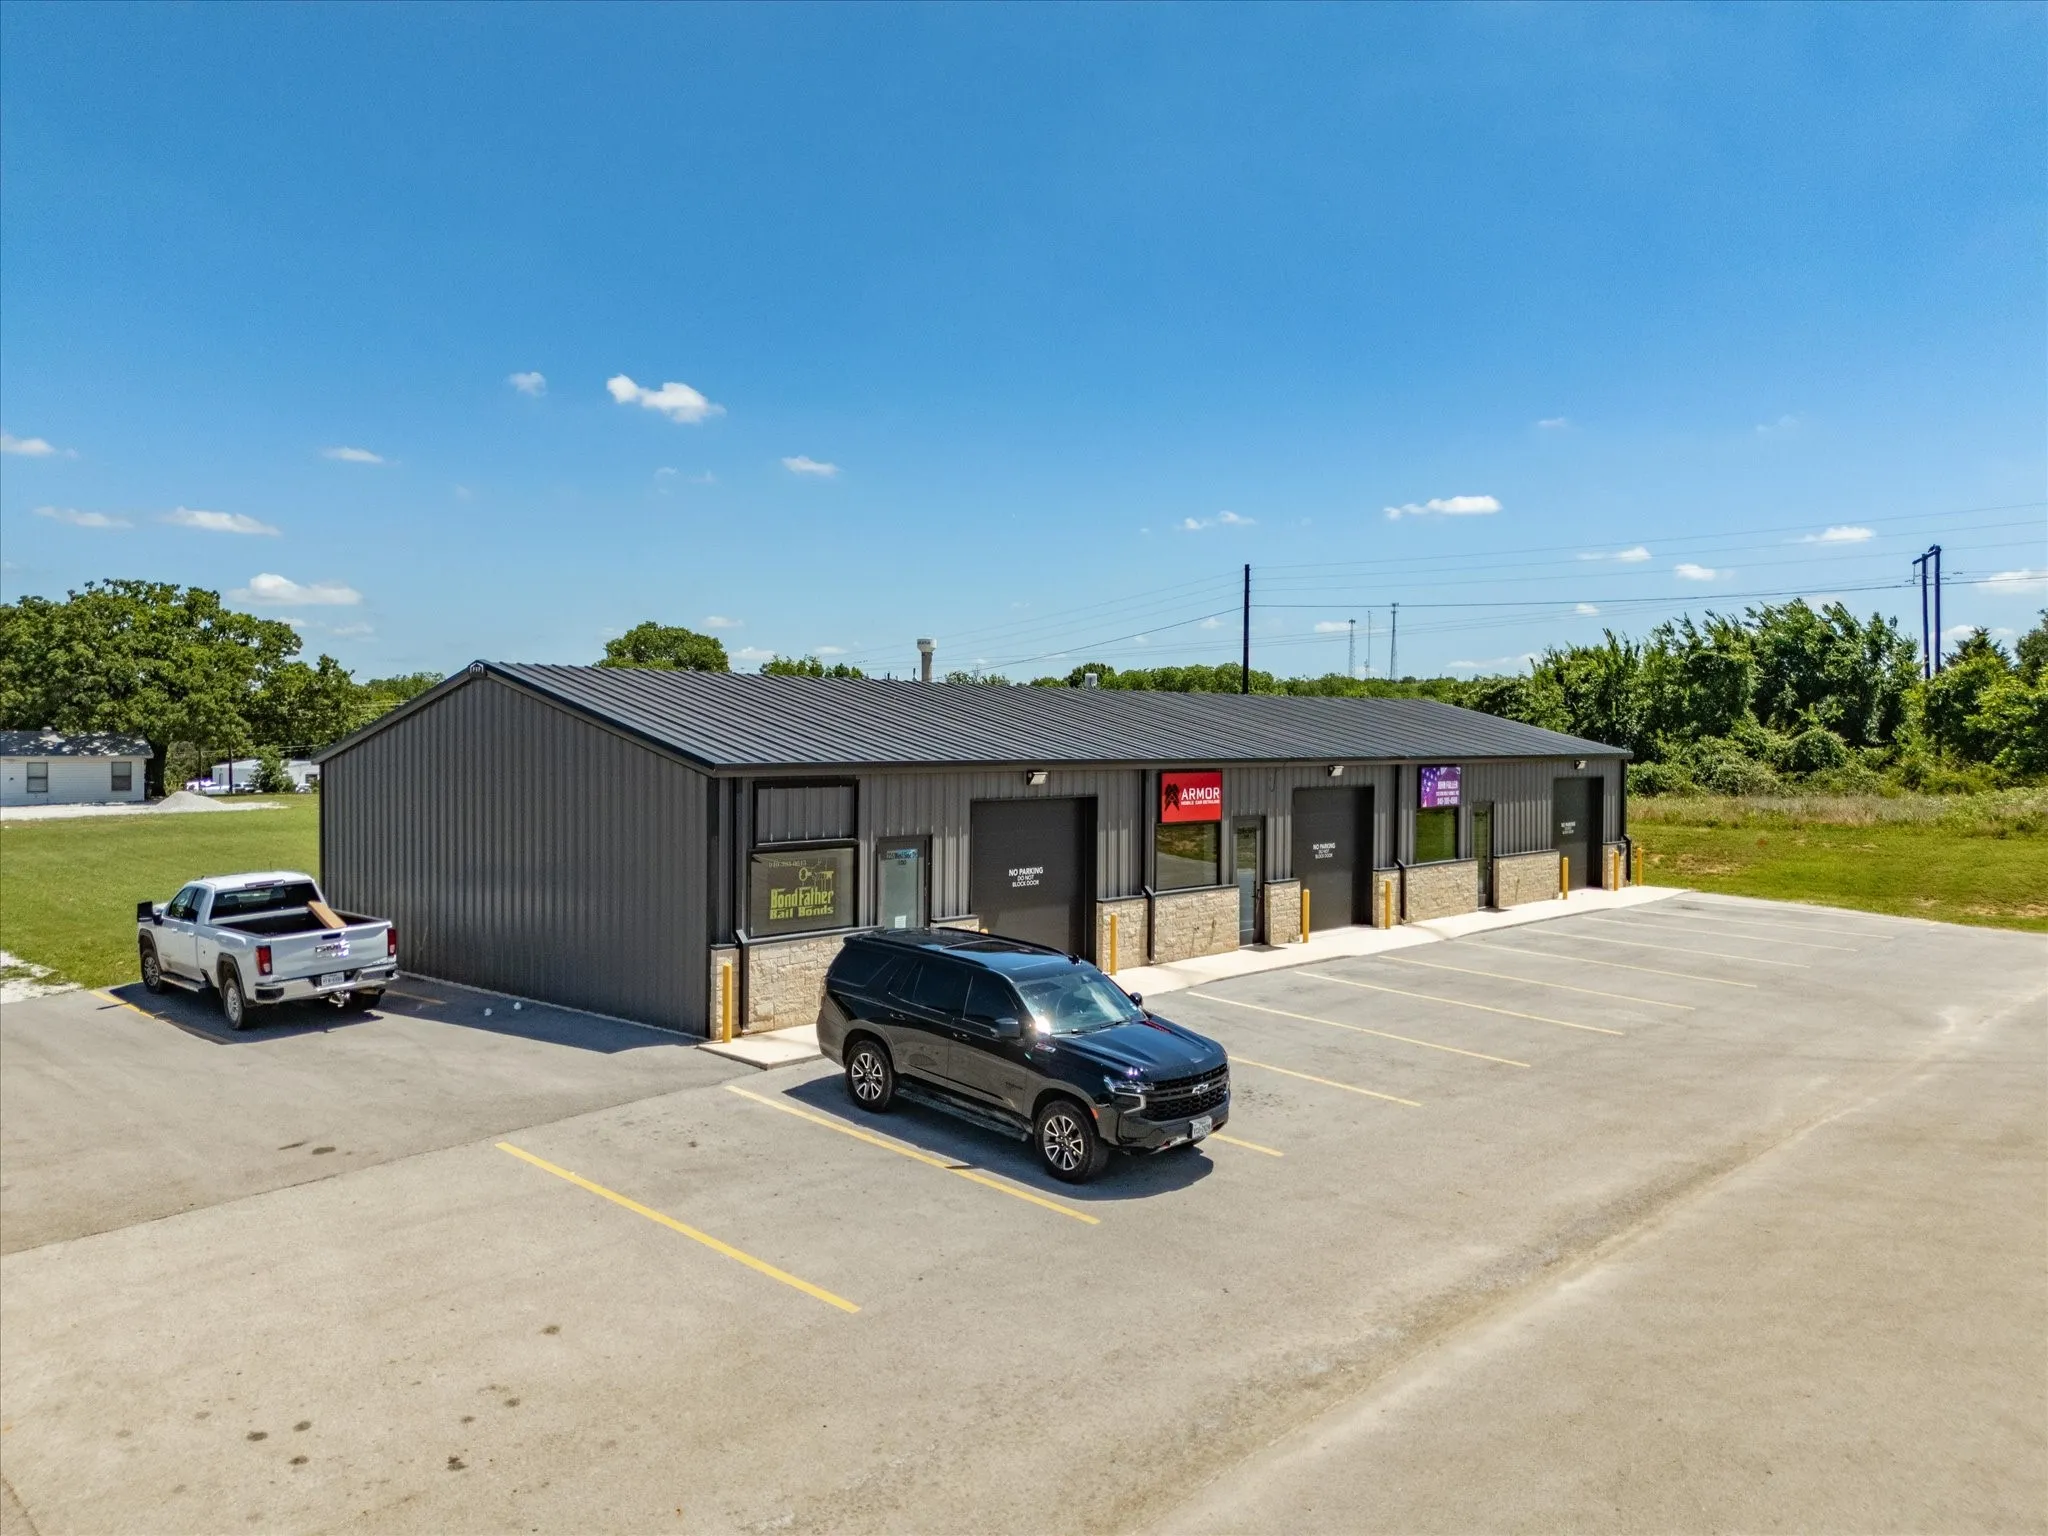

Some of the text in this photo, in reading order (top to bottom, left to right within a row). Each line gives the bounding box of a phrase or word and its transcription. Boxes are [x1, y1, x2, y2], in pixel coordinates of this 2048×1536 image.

[1181, 787, 1220, 800] ARMOR
[1019, 866, 1043, 875] PARKING
[770, 886, 834, 908] BondFather
[769, 905, 834, 919] Bail Bonds
